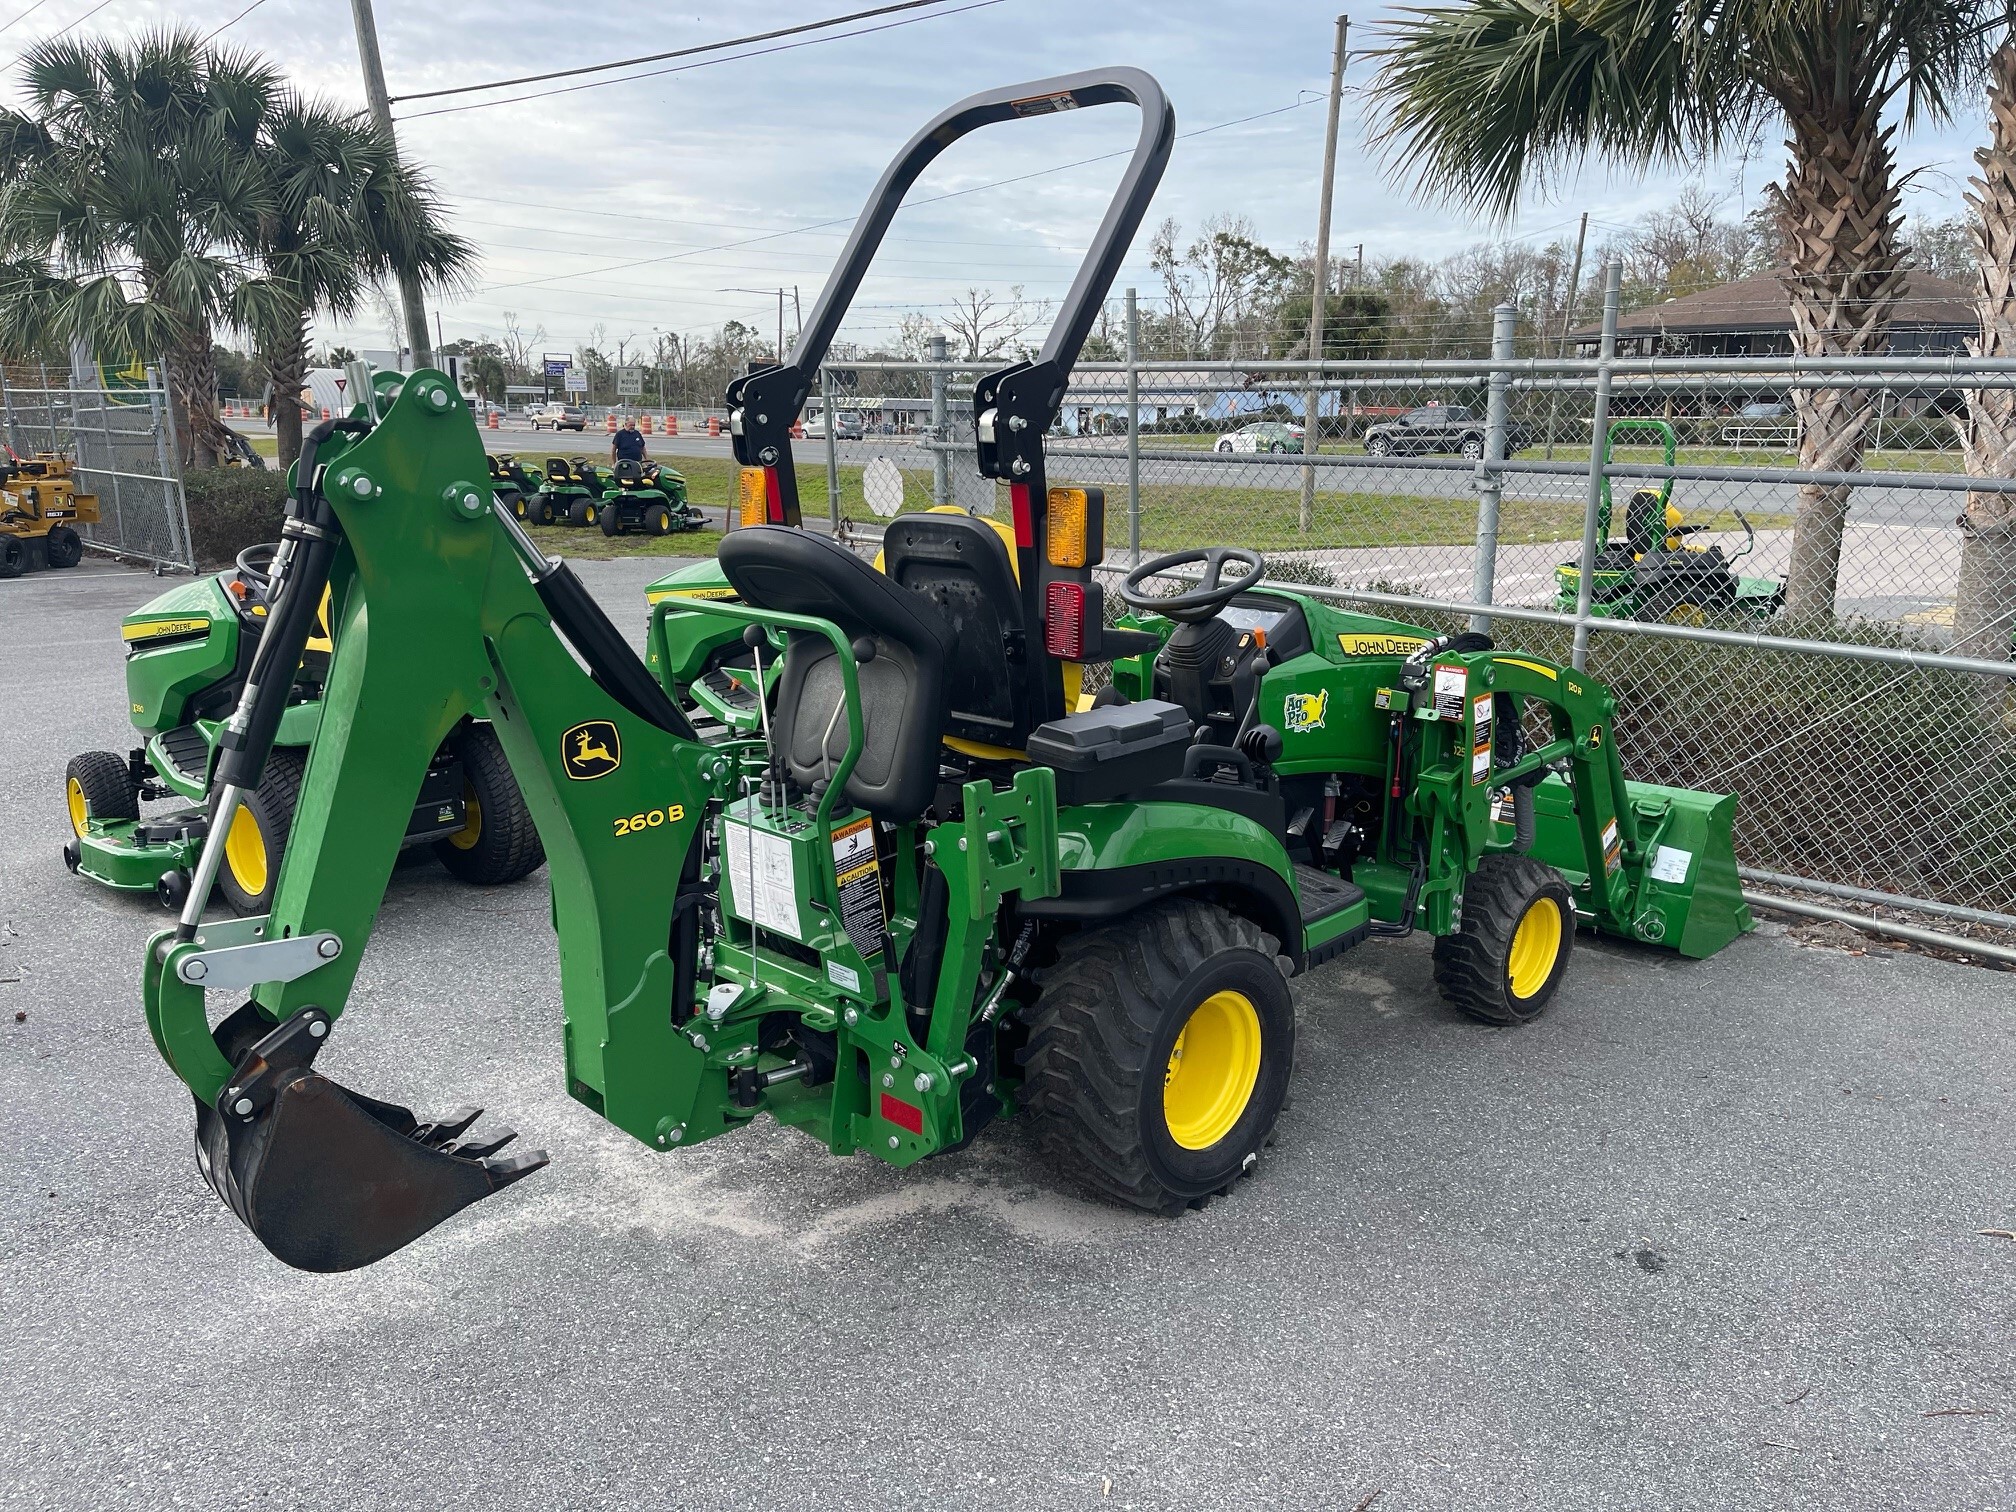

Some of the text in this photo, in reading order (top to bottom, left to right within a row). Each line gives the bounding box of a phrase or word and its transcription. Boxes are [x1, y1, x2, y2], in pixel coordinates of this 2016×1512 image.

[706, 590, 727, 598] DEERE
[156, 623, 192, 636] JOHN DEERE
[1352, 638, 1422, 653] JOHN DEERE
[1287, 711, 1308, 725] Pro
[613, 803, 685, 837] 260 B
[839, 821, 868, 838] WARNING
[847, 865, 874, 880] CAUTION
